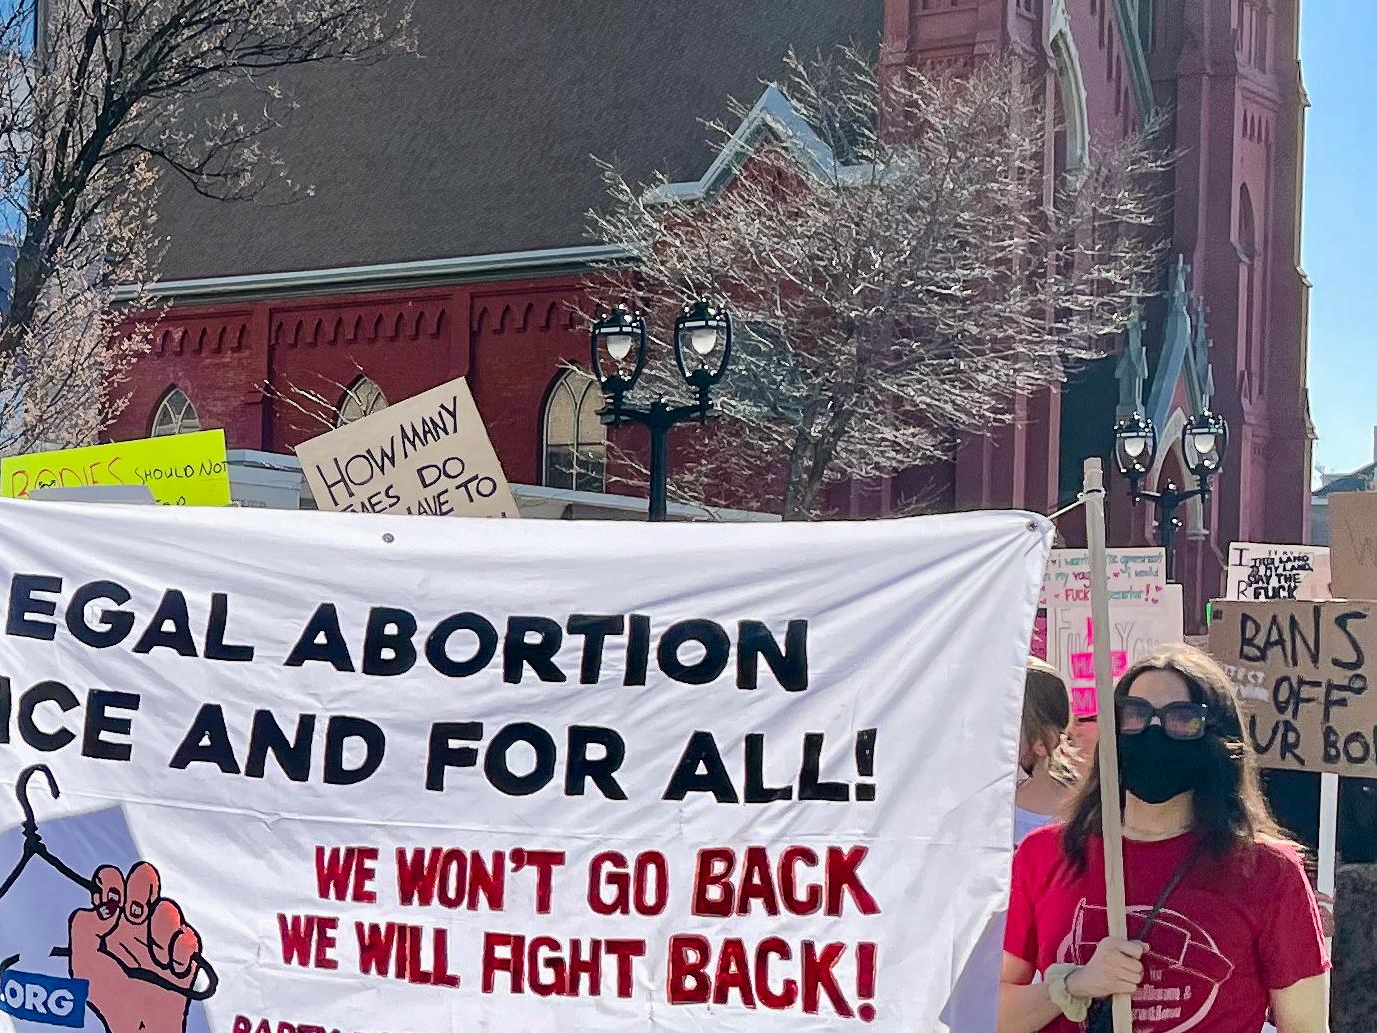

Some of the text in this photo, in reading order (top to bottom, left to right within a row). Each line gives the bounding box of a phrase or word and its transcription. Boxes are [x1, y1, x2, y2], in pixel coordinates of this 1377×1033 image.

[134, 464, 195, 486] SHOULD
[199, 458, 229, 476] NOT
[315, 395, 457, 506] HOW MANY
[416, 456, 465, 489] DO
[455, 473, 497, 503] TO
[1064, 588, 1091, 602] FUCK
[1253, 584, 1299, 600] FUCK
[1274, 573, 1302, 585] THE
[283, 602, 809, 692] ABORTION
[1239, 604, 1368, 671] BANS
[1274, 673, 1368, 722] OFF
[168, 702, 386, 786] AND
[424, 721, 629, 801] FOR
[661, 728, 879, 805] ALL!
[1323, 725, 1377, 764] BO
[314, 844, 882, 918] WE WON'T GO BACK
[276, 913, 879, 1023] WE WILL FIGHT BACK!
